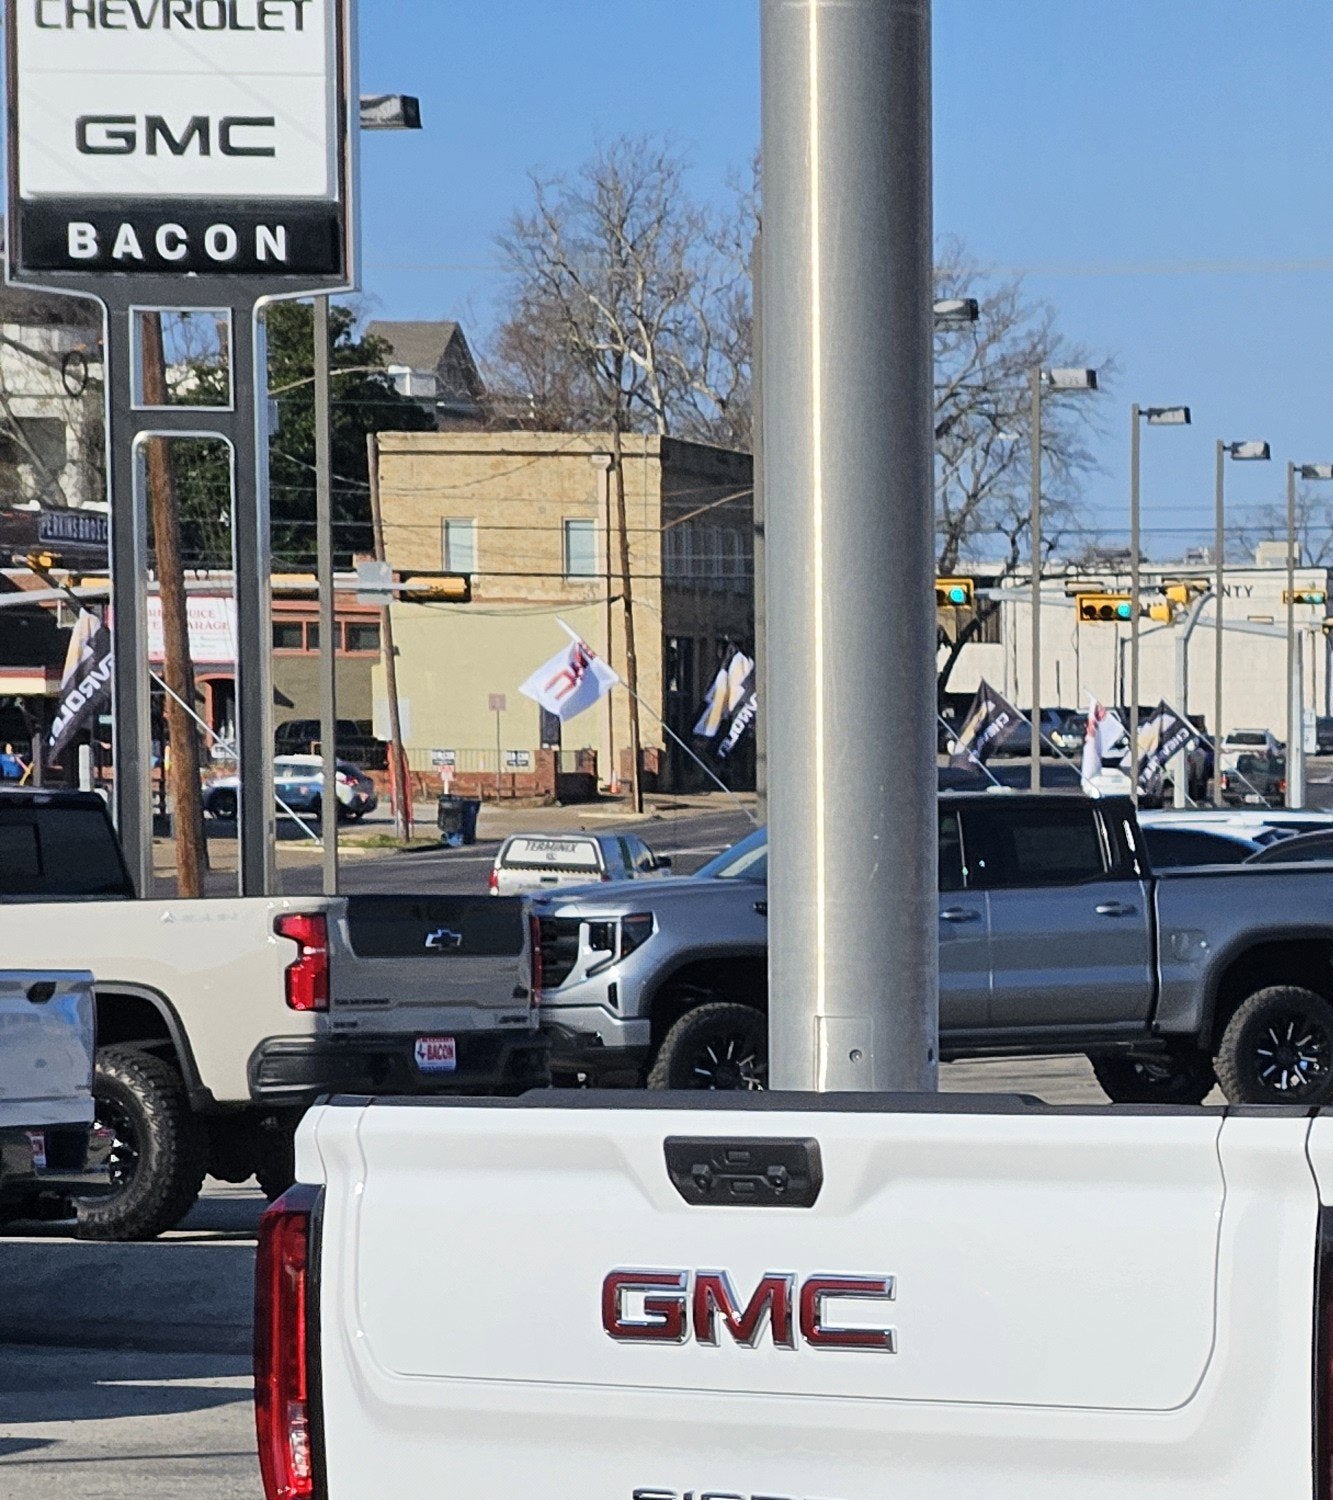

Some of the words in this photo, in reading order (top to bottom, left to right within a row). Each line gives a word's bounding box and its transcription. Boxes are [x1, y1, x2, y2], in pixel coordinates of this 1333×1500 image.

[35, 0, 309, 31] CHEVROLET
[75, 115, 276, 157] GMC
[67, 222, 287, 261] BACON
[601, 1266, 898, 1354] GMC
